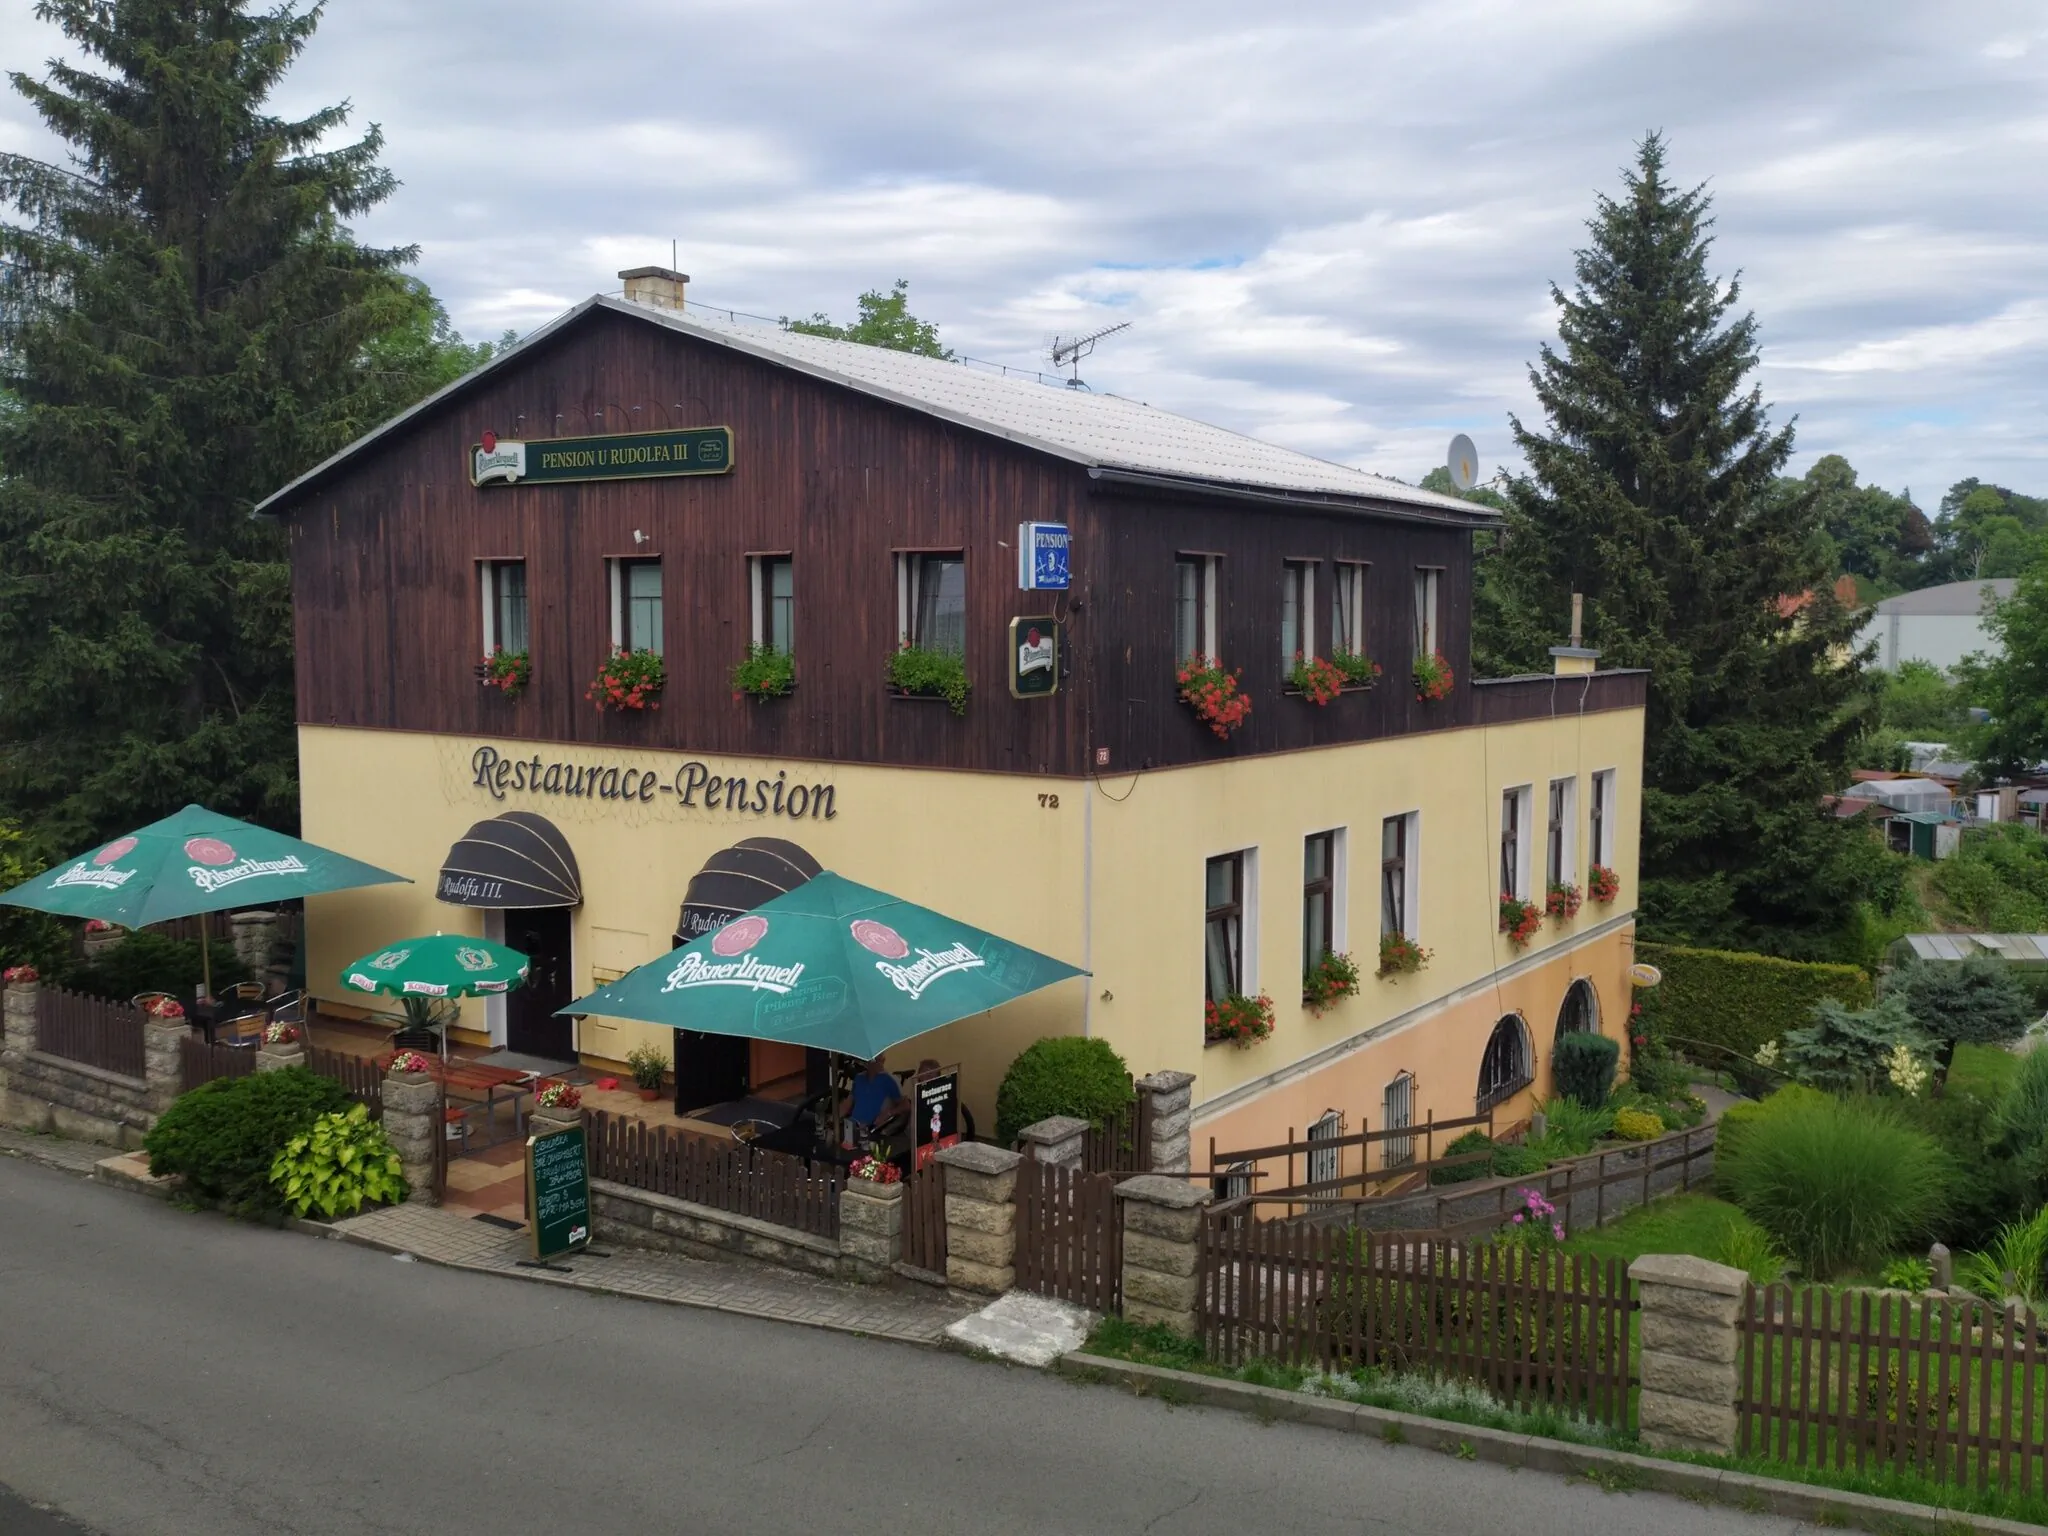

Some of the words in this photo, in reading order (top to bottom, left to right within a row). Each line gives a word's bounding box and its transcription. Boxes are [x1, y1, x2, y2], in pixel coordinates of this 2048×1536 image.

[542, 449, 594, 468] PENSION
[599, 450, 607, 466] U
[610, 446, 669, 464] RUDOLFA
[673, 444, 688, 460] III
[1036, 533, 1068, 549] PENSION
[1099, 752, 1107, 761] 72
[472, 745, 837, 820] Restaurace-Pension
[1038, 794, 1059, 808] 72
[444, 876, 479, 901] Rudolfa
[682, 908, 691, 928] U
[690, 912, 730, 934] Rudolf
